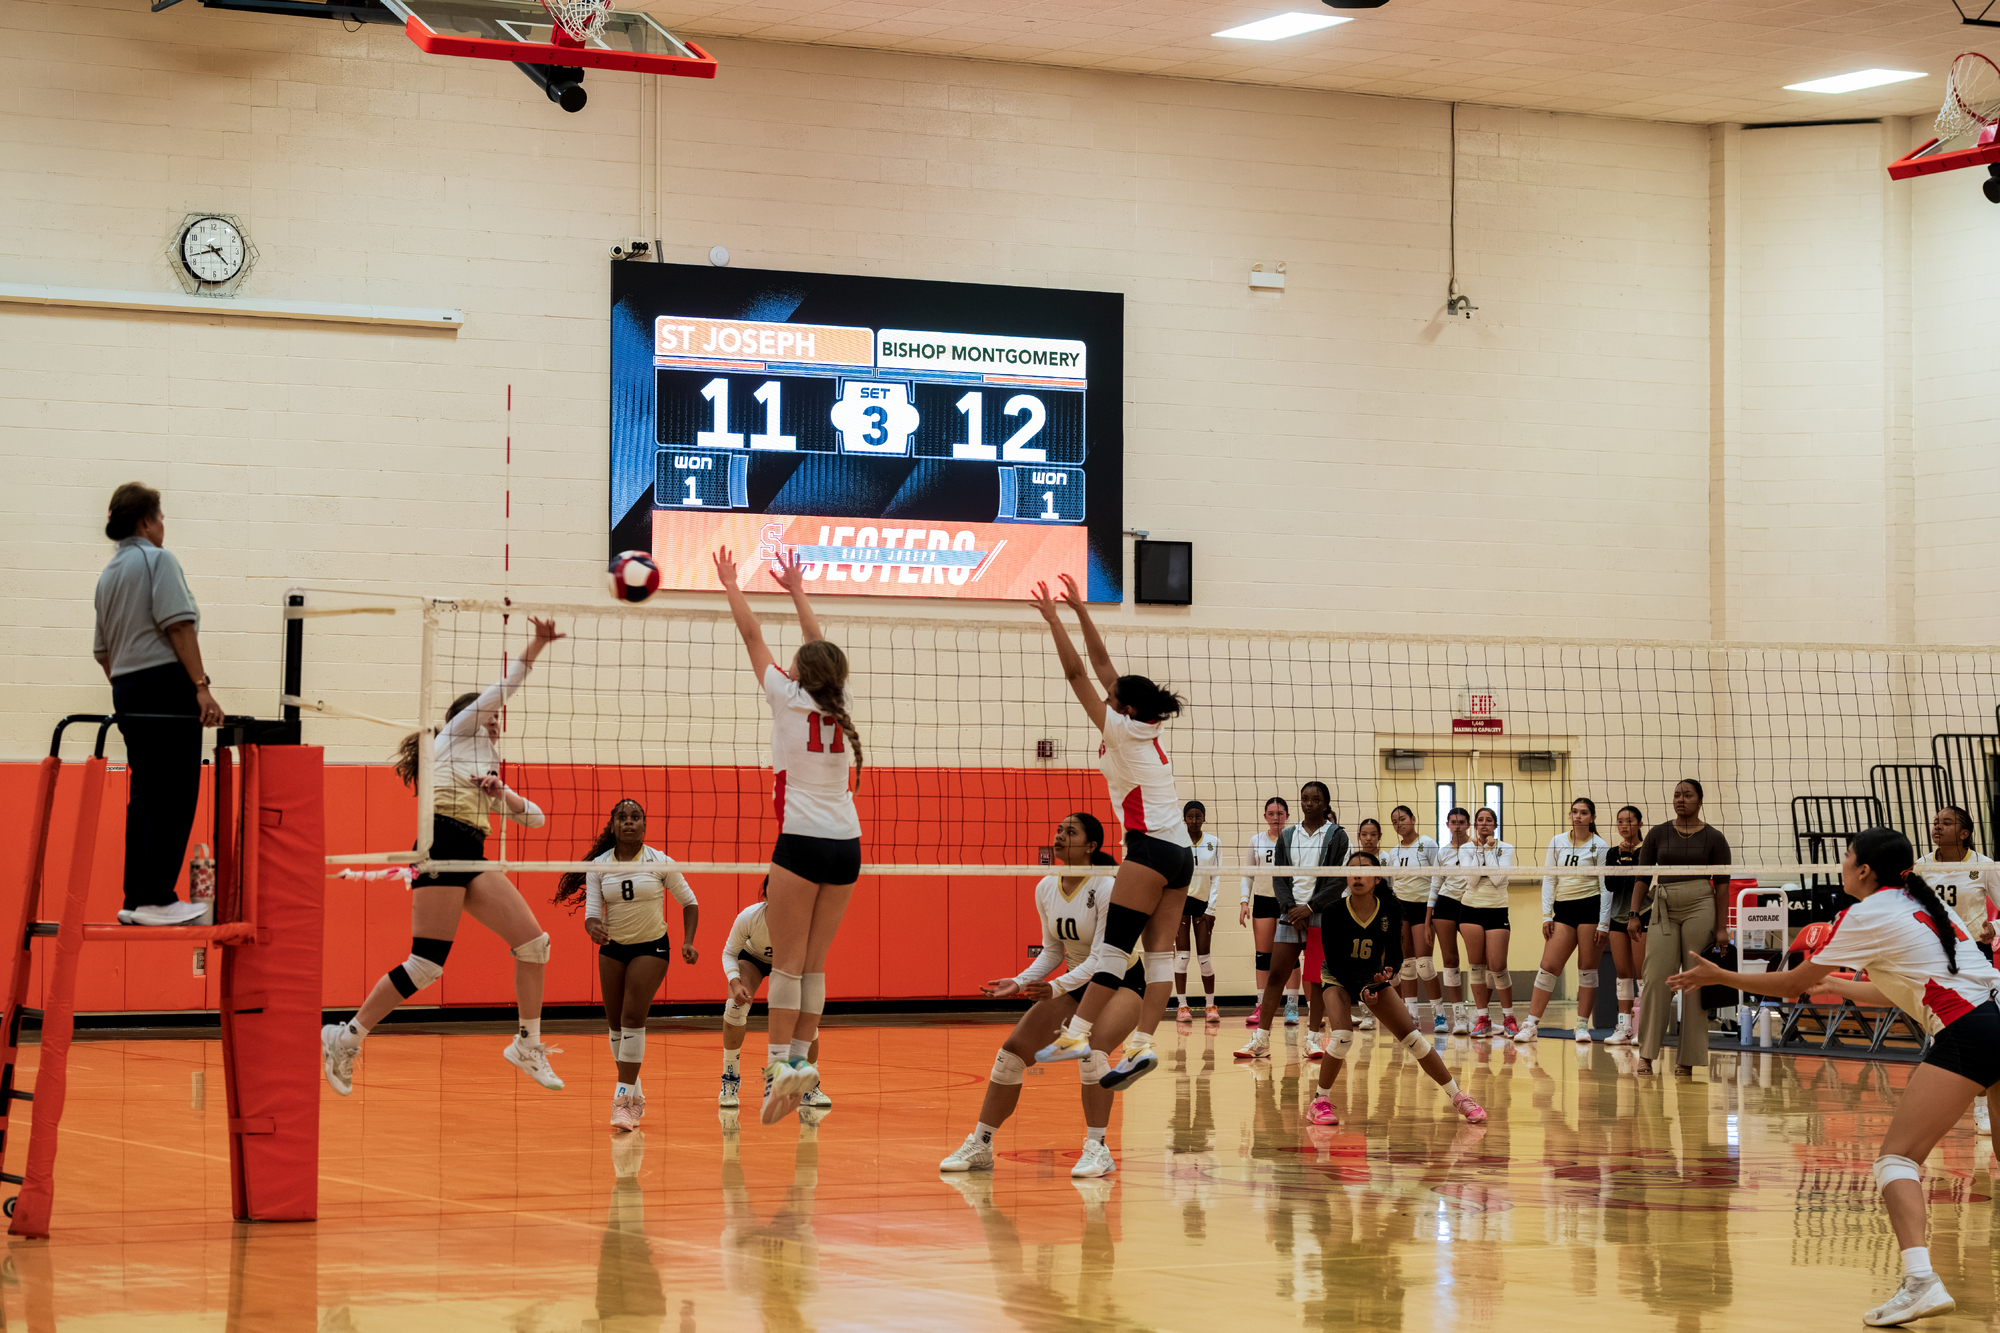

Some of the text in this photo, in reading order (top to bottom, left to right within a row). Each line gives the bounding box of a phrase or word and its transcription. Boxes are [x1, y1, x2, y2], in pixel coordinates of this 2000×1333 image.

[235, 247, 239, 255] 3
[661, 324, 815, 357] ST JOSEPH
[882, 341, 1080, 368] BISHOP MONTGOMERY
[860, 387, 890, 400] SET
[697, 377, 797, 450] 11
[862, 405, 888, 446] 3
[952, 391, 1046, 462] 12
[683, 476, 702, 505] 1
[1041, 491, 1059, 520] 1
[801, 525, 976, 586] JESTERS
[842, 548, 936, 563] SAINT JOSEPH
[1471, 695, 1492, 714] EXIT
[807, 711, 845, 753] 17
[621, 880, 634, 901] 8
[1935, 884, 1957, 907] 33
[1056, 917, 1080, 941] 10
[1747, 914, 1780, 922] GATORADE
[1350, 938, 1373, 960] 16
